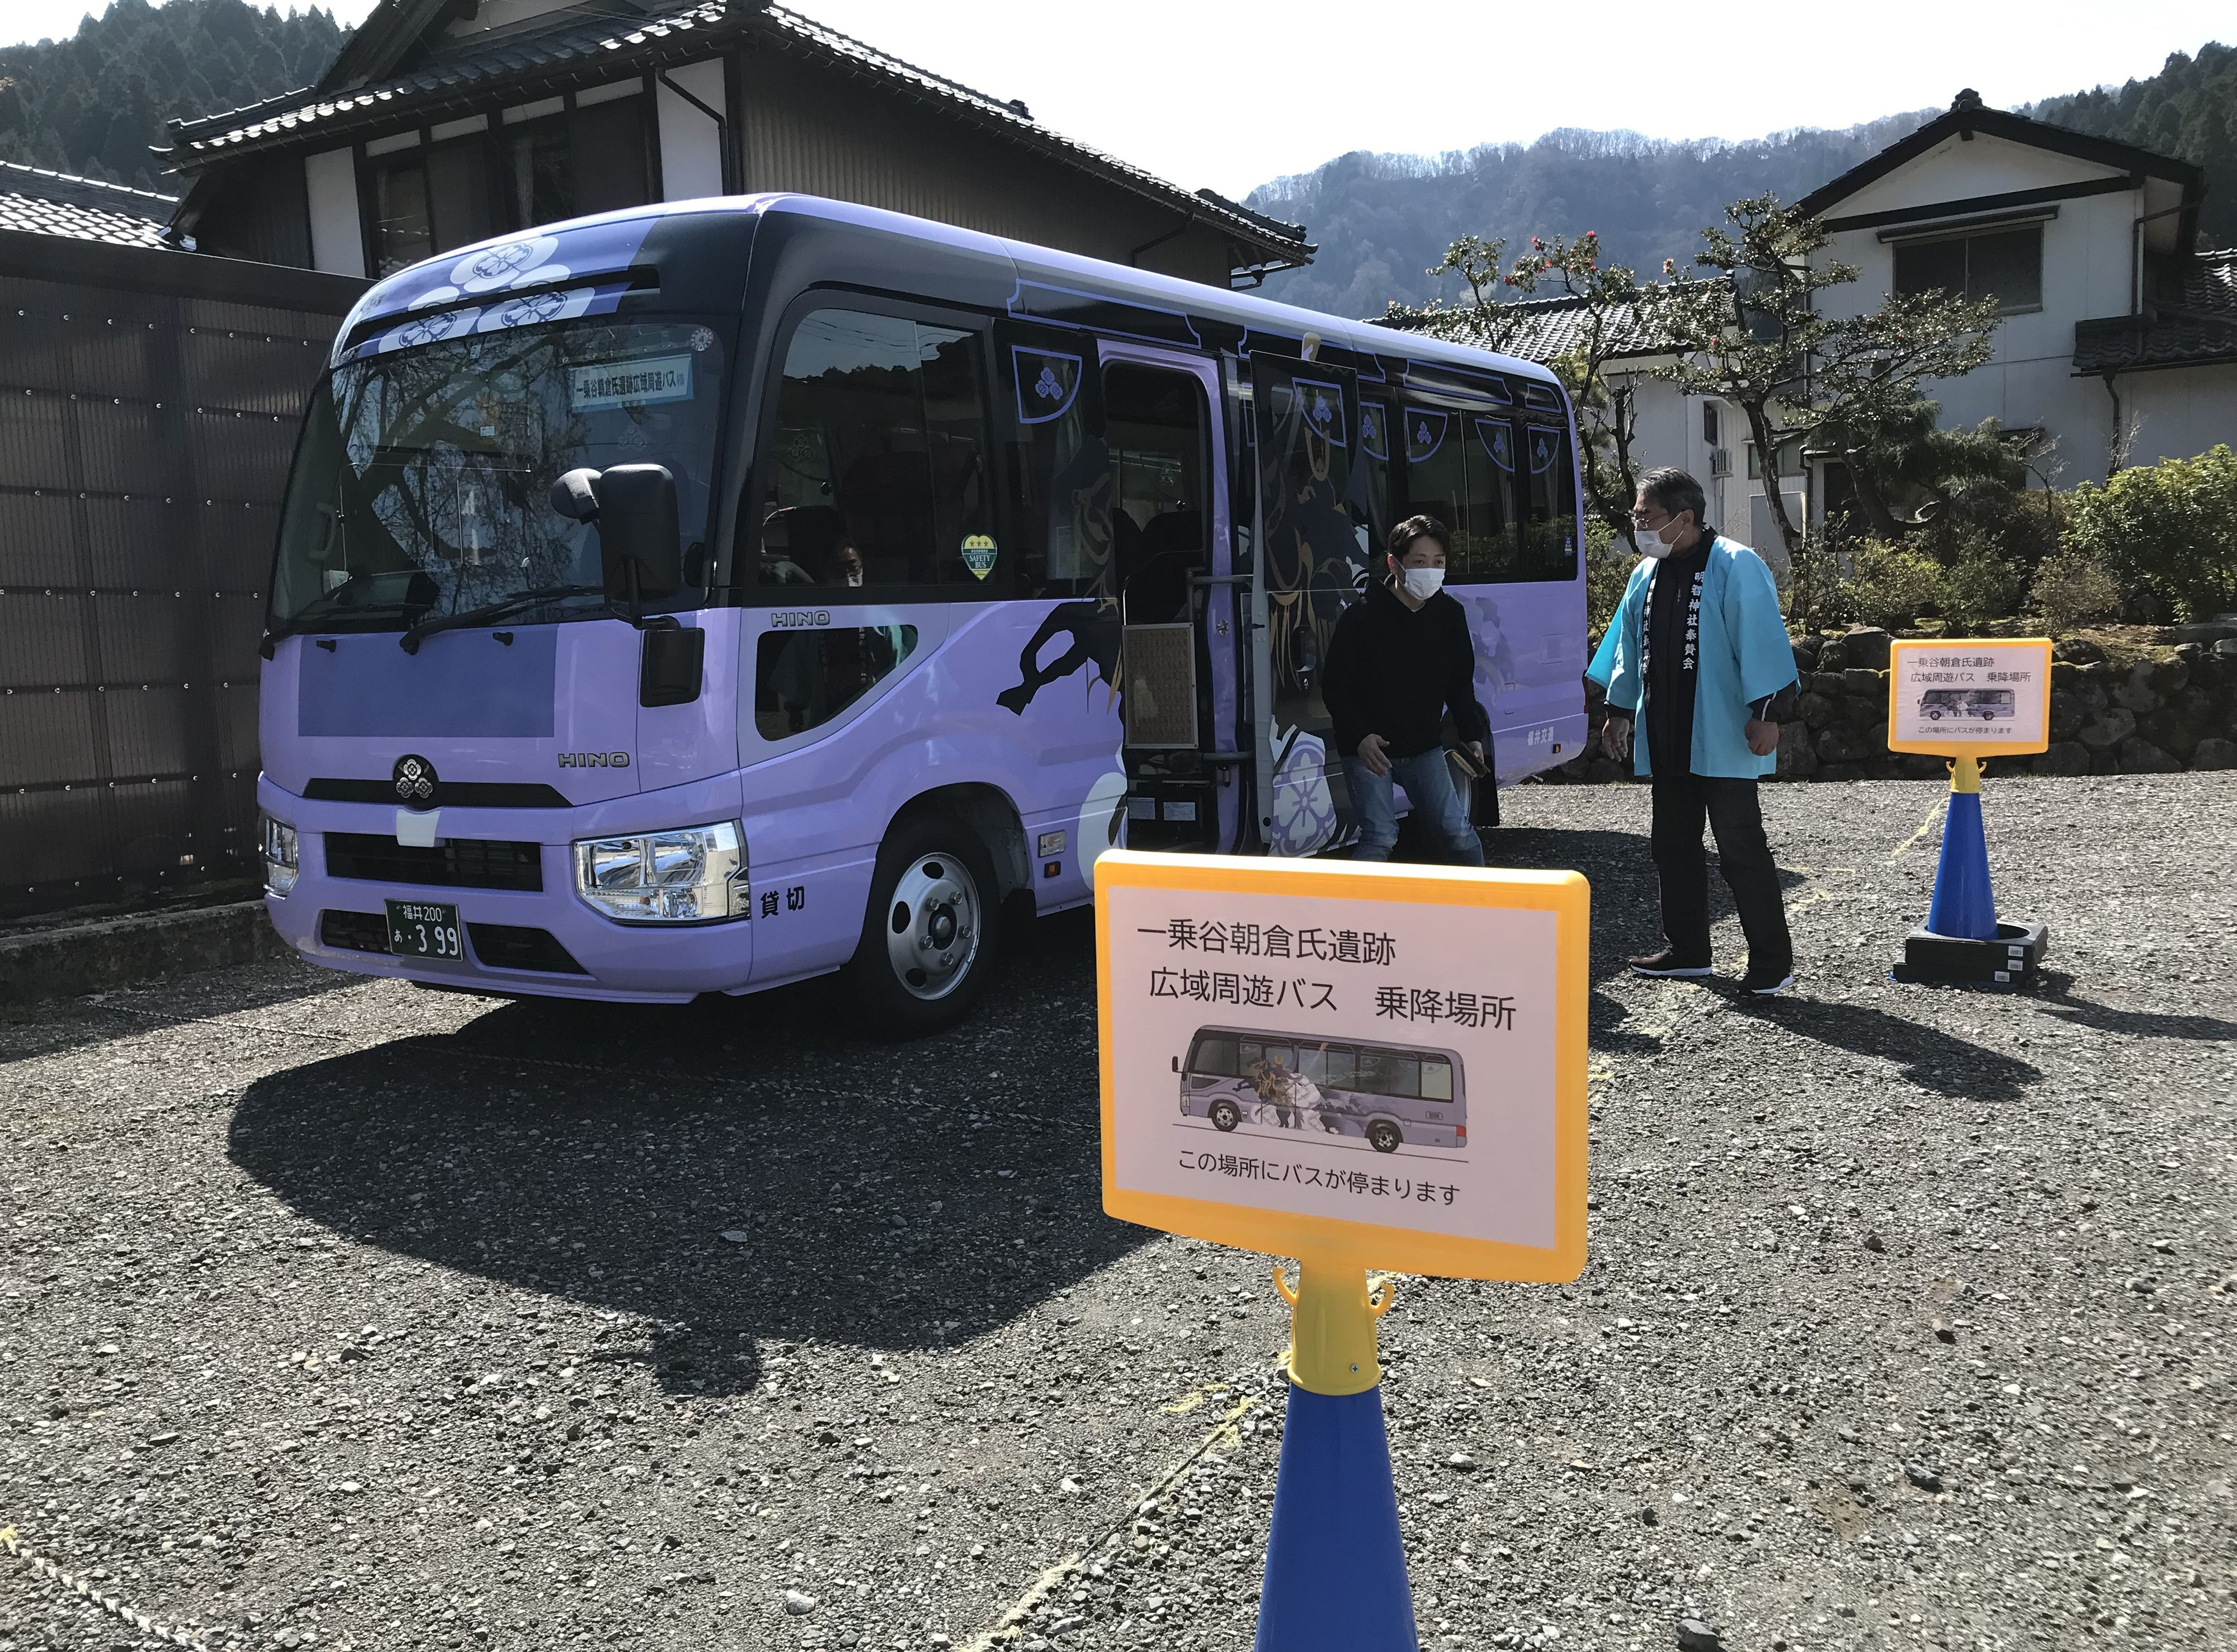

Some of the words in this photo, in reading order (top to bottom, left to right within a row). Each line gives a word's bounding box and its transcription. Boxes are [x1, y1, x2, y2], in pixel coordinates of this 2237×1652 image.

[771, 610, 830, 627] HINO
[1683, 571, 1705, 670] 明智神社奉賛会
[1907, 657, 1995, 668] 一乗谷朝倉氏遺跡
[1910, 672, 1975, 682] 広域周遊バス
[1986, 672, 2031, 682] 乗降場所
[558, 752, 630, 768] HINO
[761, 886, 805, 919] 貸切
[1137, 918, 1396, 966] 一乗谷朝倉氏遺跡
[1150, 966, 1337, 1011] 広域周遊バス
[1375, 986, 1517, 1031] 乗降場所
[1179, 1150, 1460, 1205] この場所にバスが停まります
